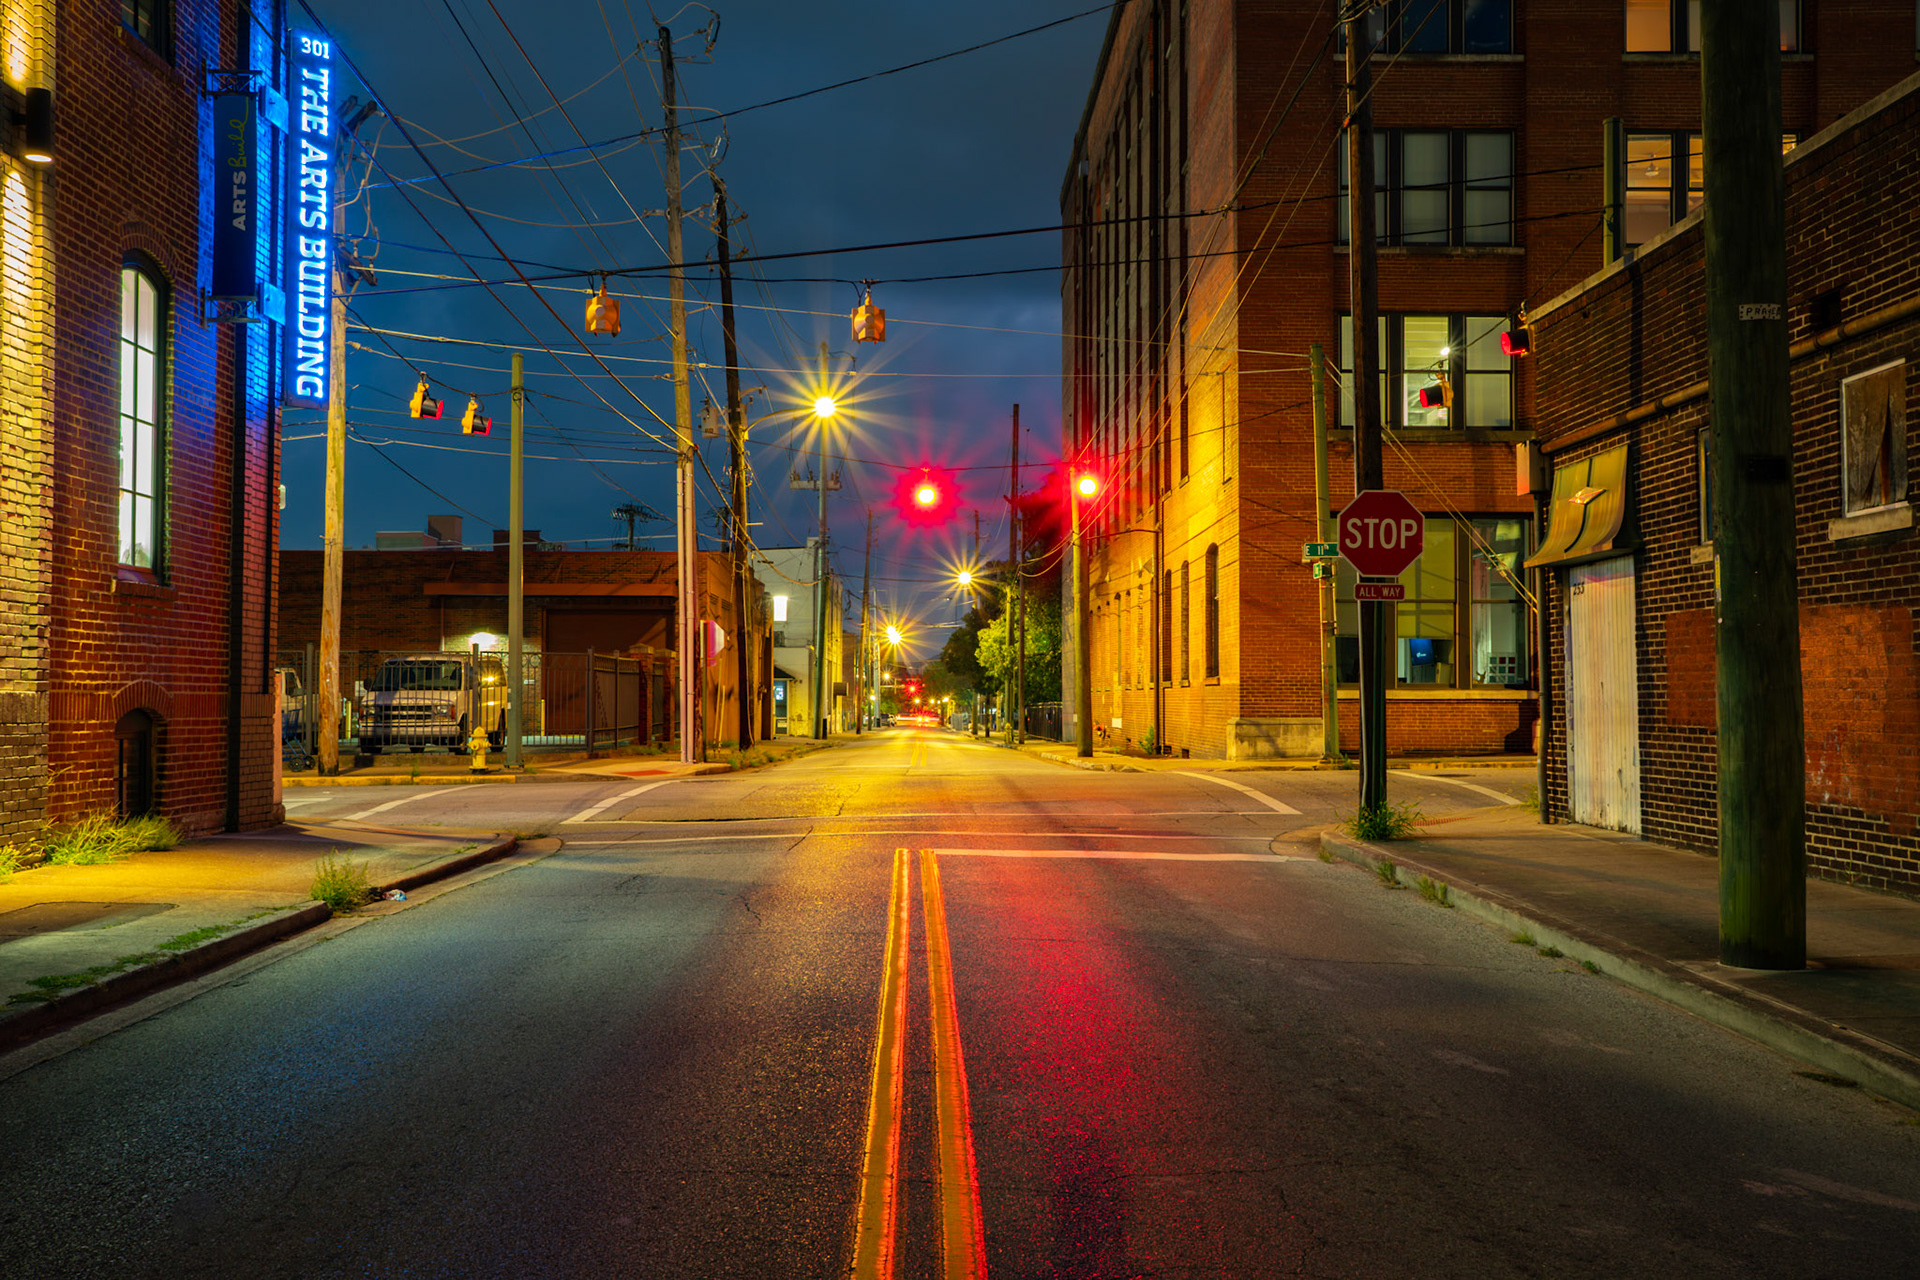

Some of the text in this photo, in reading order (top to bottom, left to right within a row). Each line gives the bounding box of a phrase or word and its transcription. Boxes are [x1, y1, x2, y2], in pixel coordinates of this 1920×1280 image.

[301, 37, 330, 60] 301
[228, 97, 249, 231] ARTS Build
[296, 68, 329, 399] THE ARTS BUILDING
[1344, 517, 1418, 550] STOP
[1305, 545, 1311, 556] E
[1359, 587, 1401, 598] ALL WAY
